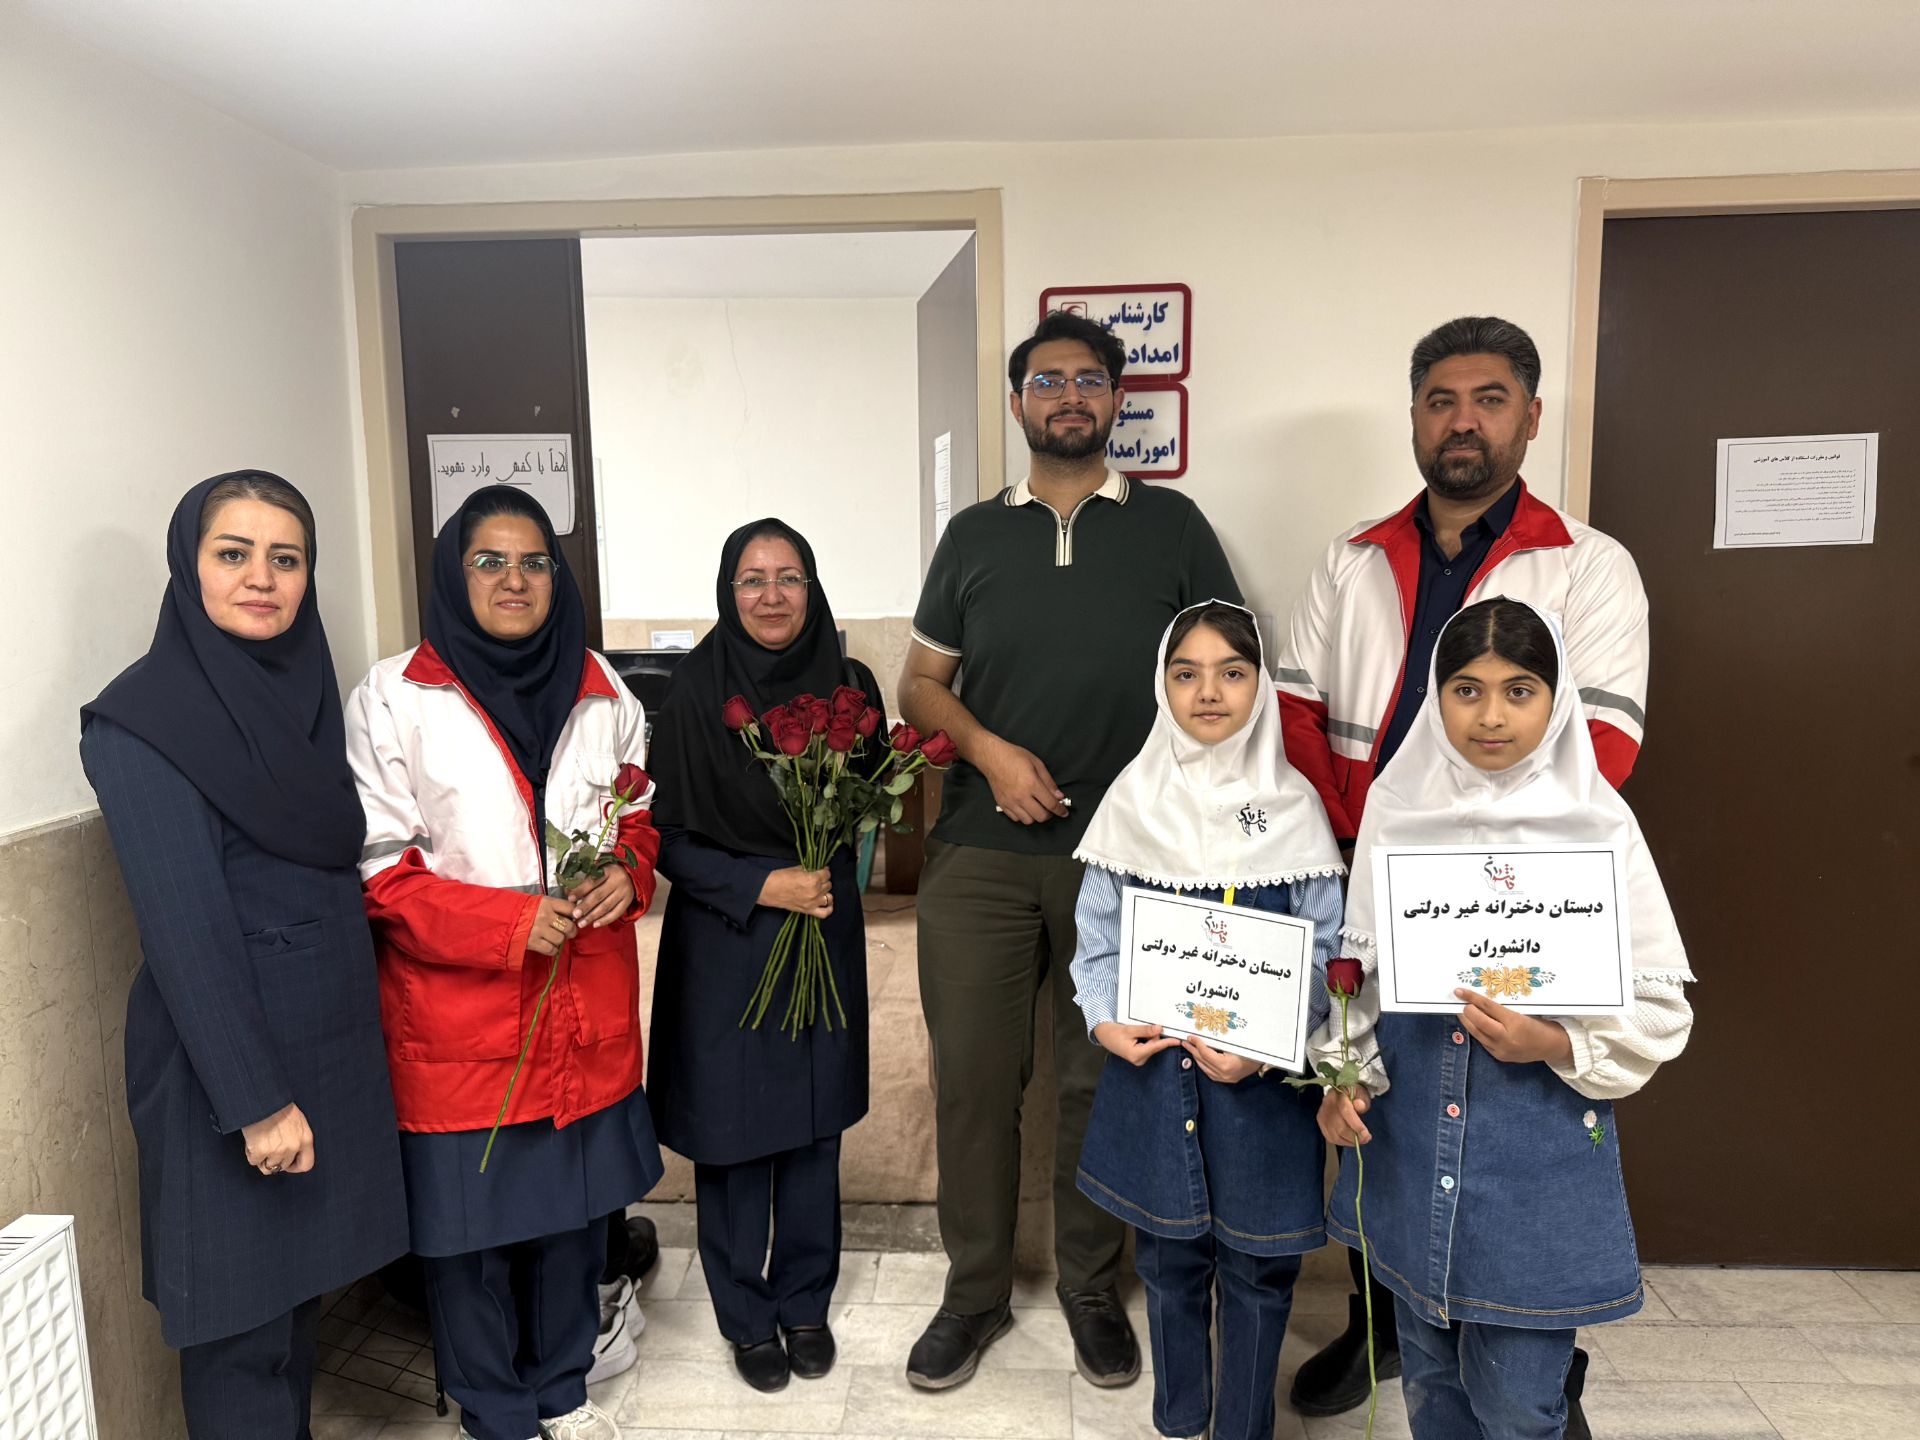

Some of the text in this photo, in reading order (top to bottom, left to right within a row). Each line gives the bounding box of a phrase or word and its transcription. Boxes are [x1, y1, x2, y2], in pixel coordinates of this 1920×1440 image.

[1100, 302, 1169, 331] کارشناس
[1116, 401, 1155, 426] مسئو
[537, 451, 545, 475] با
[1104, 437, 1176, 464] امور امدا
[471, 451, 491, 477] وارد
[496, 451, 532, 482] کفش
[1404, 899, 1604, 918] دبستان دخترانه غیر دولتی
[1141, 938, 1291, 979] دبستان دخترانه غیر دولتی
[1469, 938, 1541, 958] دانشوران
[1186, 980, 1240, 1001] دانشوران
